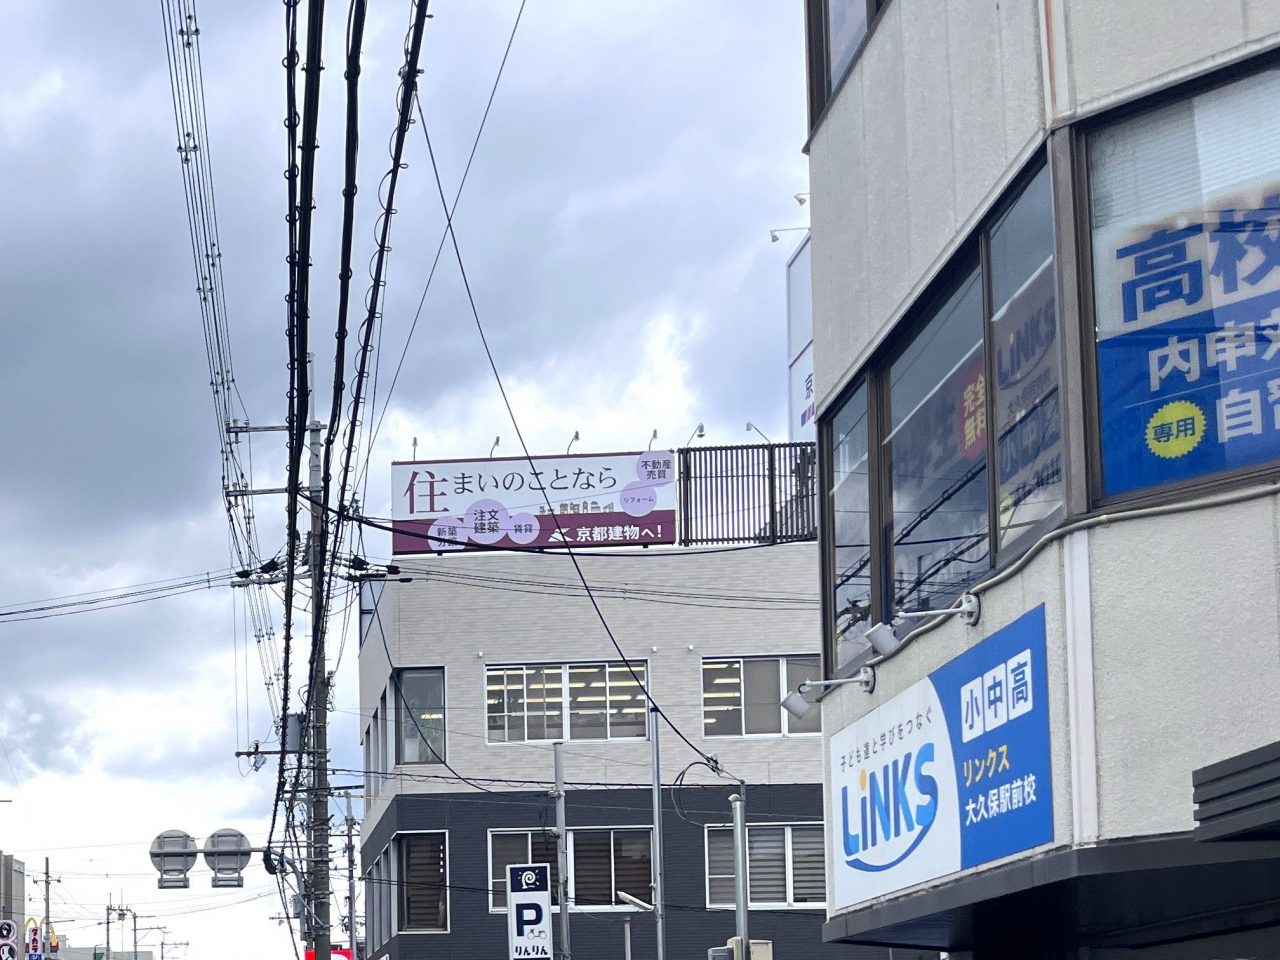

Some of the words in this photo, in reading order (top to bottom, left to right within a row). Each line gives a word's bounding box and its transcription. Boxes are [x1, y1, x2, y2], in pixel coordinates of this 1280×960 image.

[1152, 415, 1196, 444] 専用
[641, 459, 672, 470] 不動産
[646, 470, 667, 480] 売買
[404, 466, 617, 515] 住まいのことなら
[474, 509, 499, 521] 注文
[437, 526, 457, 537] 新築
[474, 521, 499, 533] 建築
[963, 660, 1030, 729] 小中高
[963, 744, 1010, 787] リンクス
[965, 775, 1037, 826] 大久保駅前校
[516, 903, 543, 937] P
[515, 946, 548, 956] りんりん
